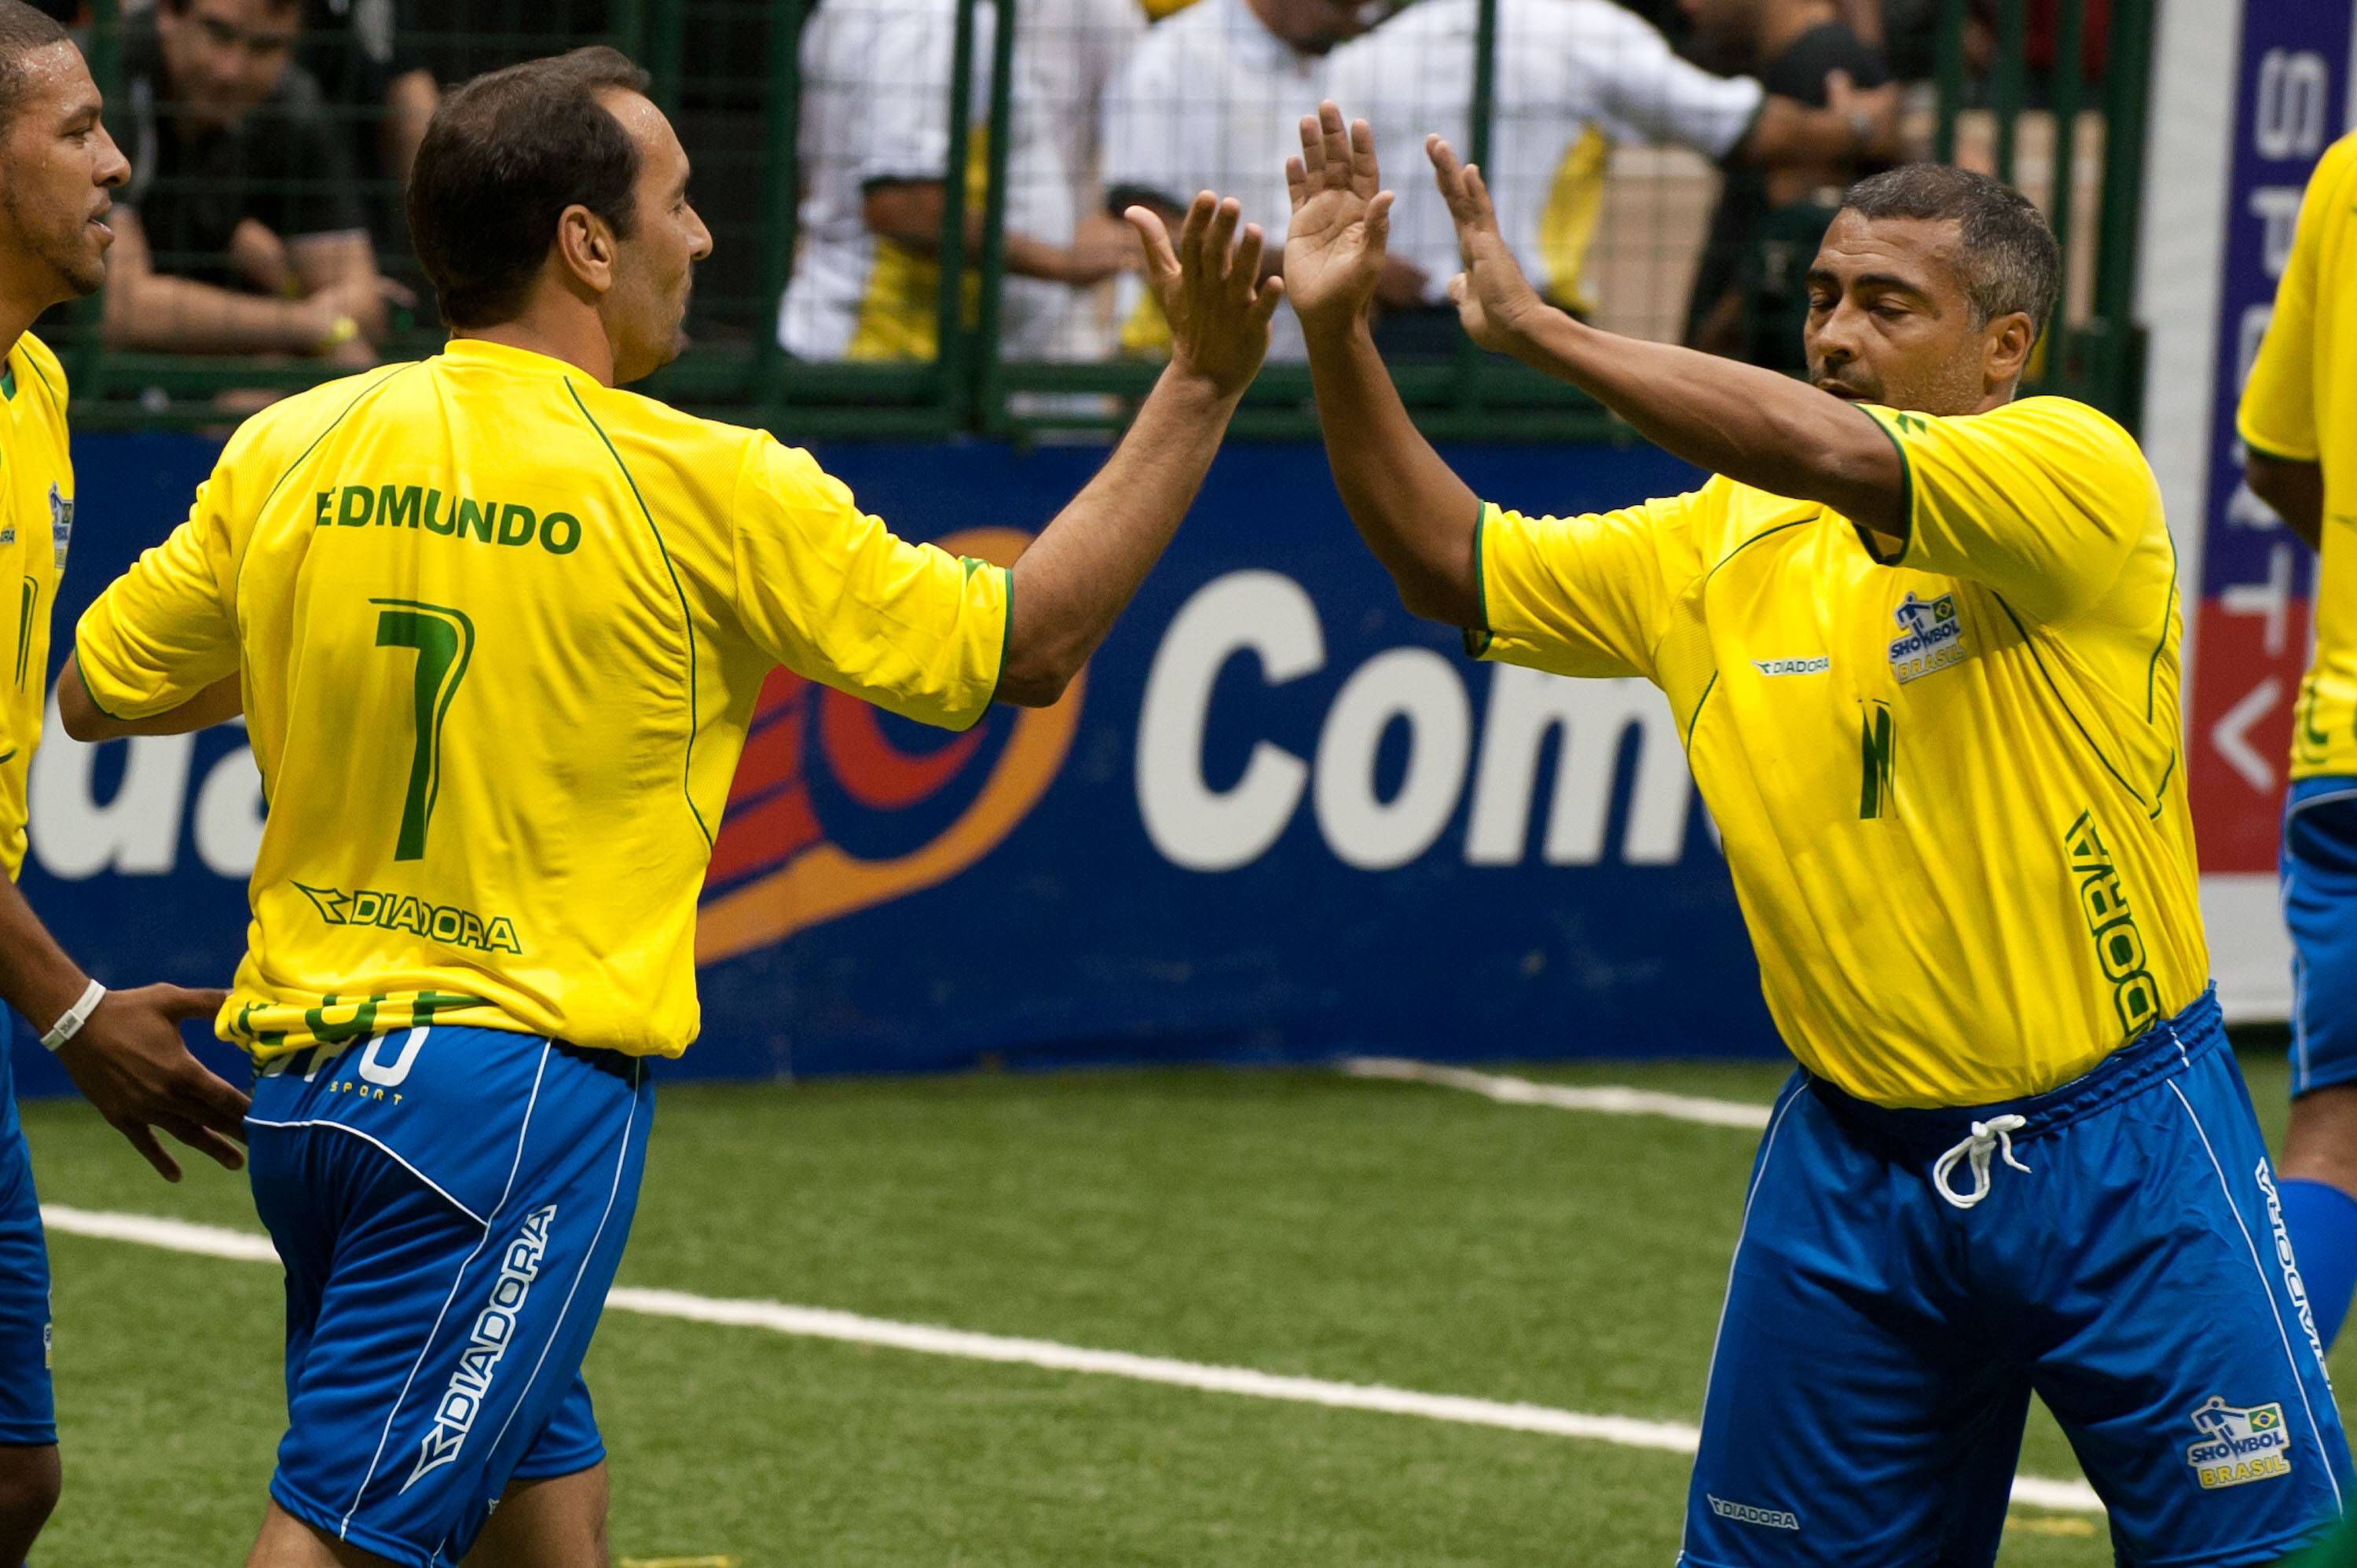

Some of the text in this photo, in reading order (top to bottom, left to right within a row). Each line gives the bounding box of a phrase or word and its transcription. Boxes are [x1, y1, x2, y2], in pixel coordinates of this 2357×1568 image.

[317, 485, 581, 555] EDMUNDO
[1890, 620, 1961, 658] SHOWBOL
[1773, 658, 1829, 673] DIADORA
[1897, 643, 1964, 680] BRASIL
[368, 599, 475, 861] 7
[1135, 568, 1724, 873] Com
[2065, 809, 2160, 1037] DORA
[329, 1080, 402, 1105] SPORT
[434, 1204, 557, 1433] DIADORA
[2191, 1431, 2284, 1464] SHOWBOL
[2201, 1455, 2287, 1487] BRASIL
[1722, 1502, 1797, 1527] DIADORA
